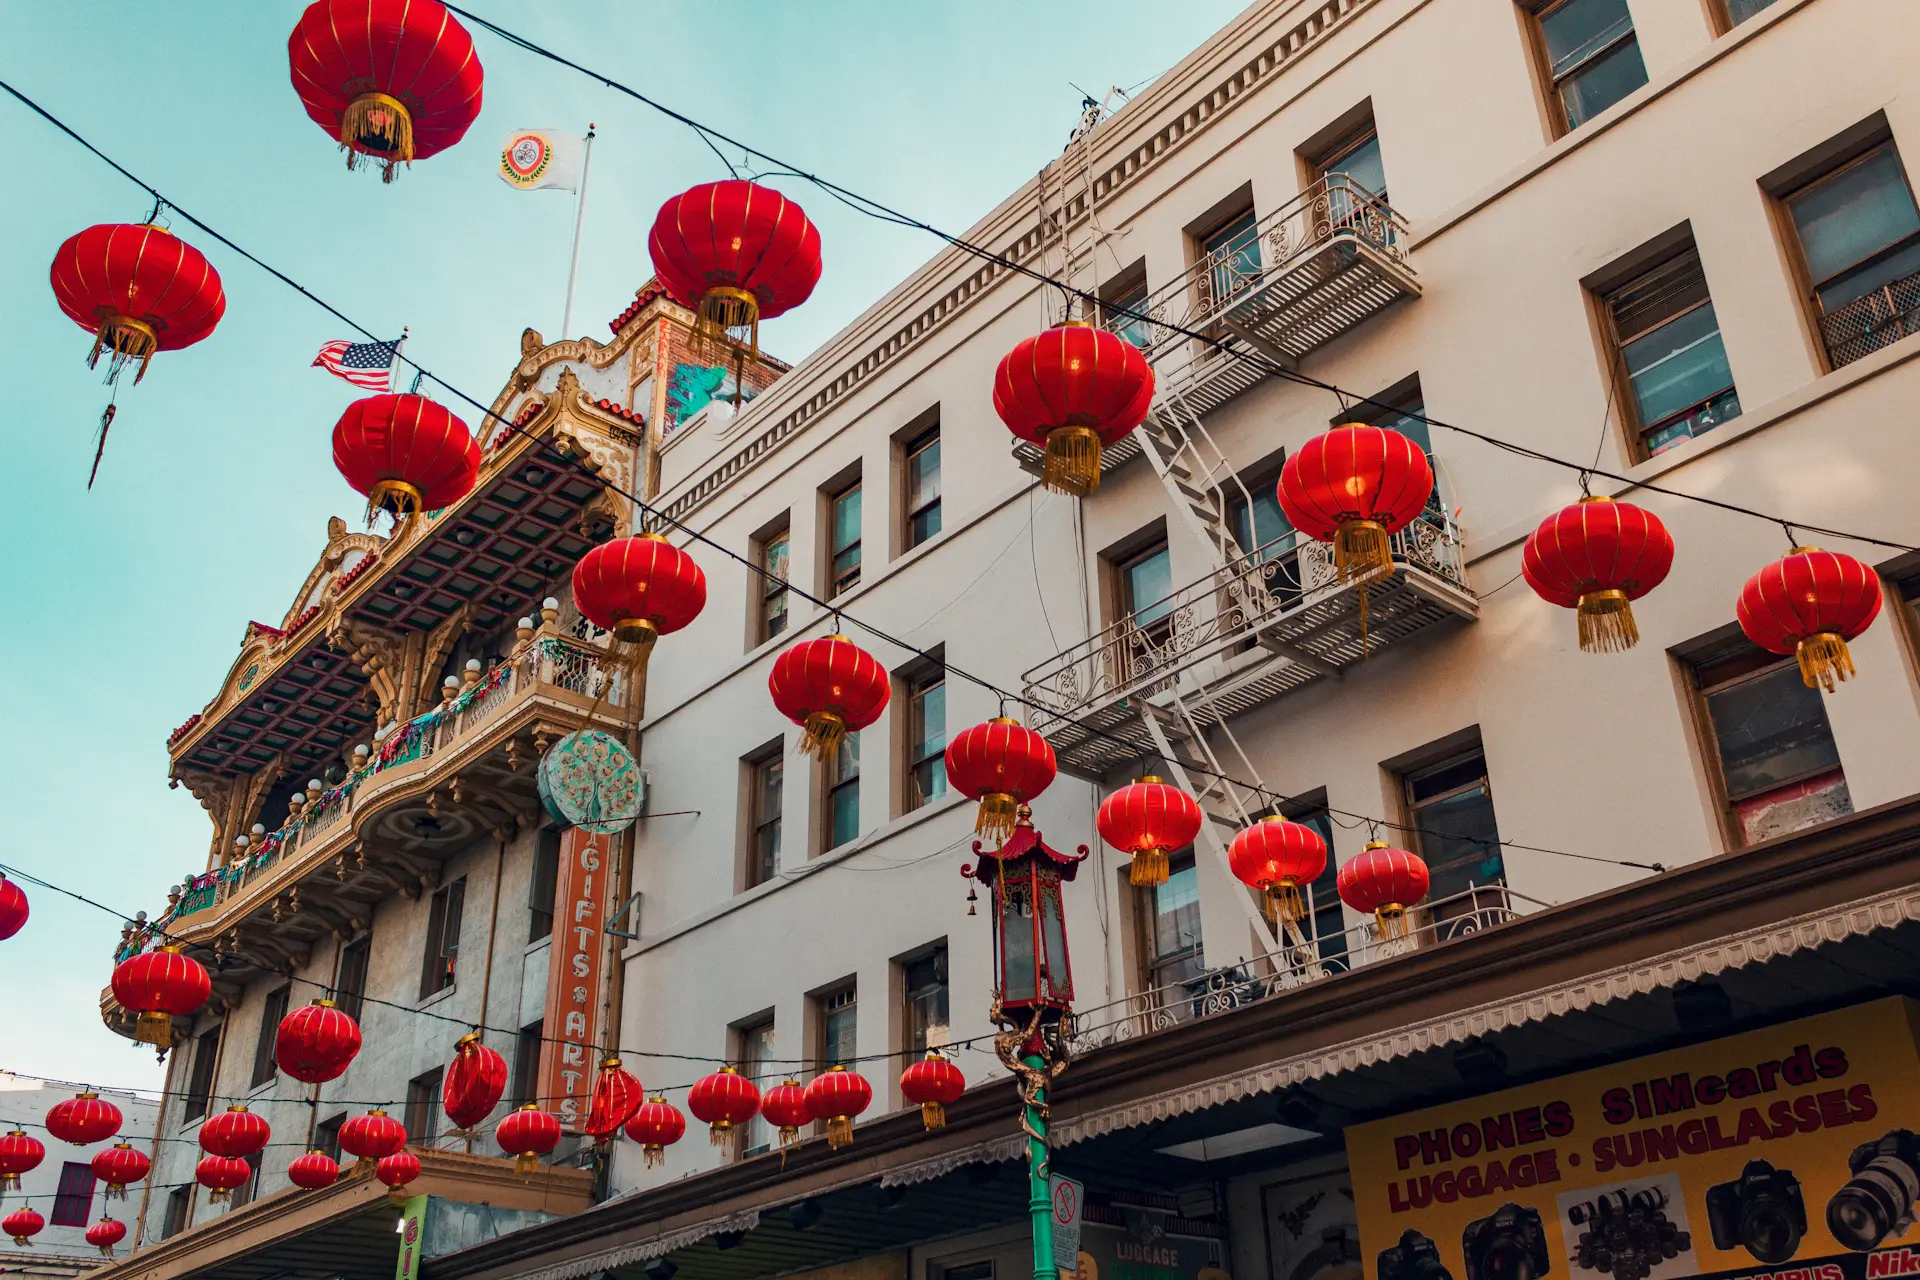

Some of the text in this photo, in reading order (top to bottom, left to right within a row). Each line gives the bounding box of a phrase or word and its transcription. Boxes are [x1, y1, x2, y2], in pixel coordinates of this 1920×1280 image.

[560, 848, 600, 1123] GIFTS & ARTS
[1388, 1084, 1878, 1213] LUGGAGE SUNGLASSES
[1394, 1044, 1849, 1170] PHONES SIMcards
[403, 1216, 419, 1280] GI
[1116, 1240, 1179, 1267] LUGGAGE
[1866, 1249, 1920, 1279] Nik
